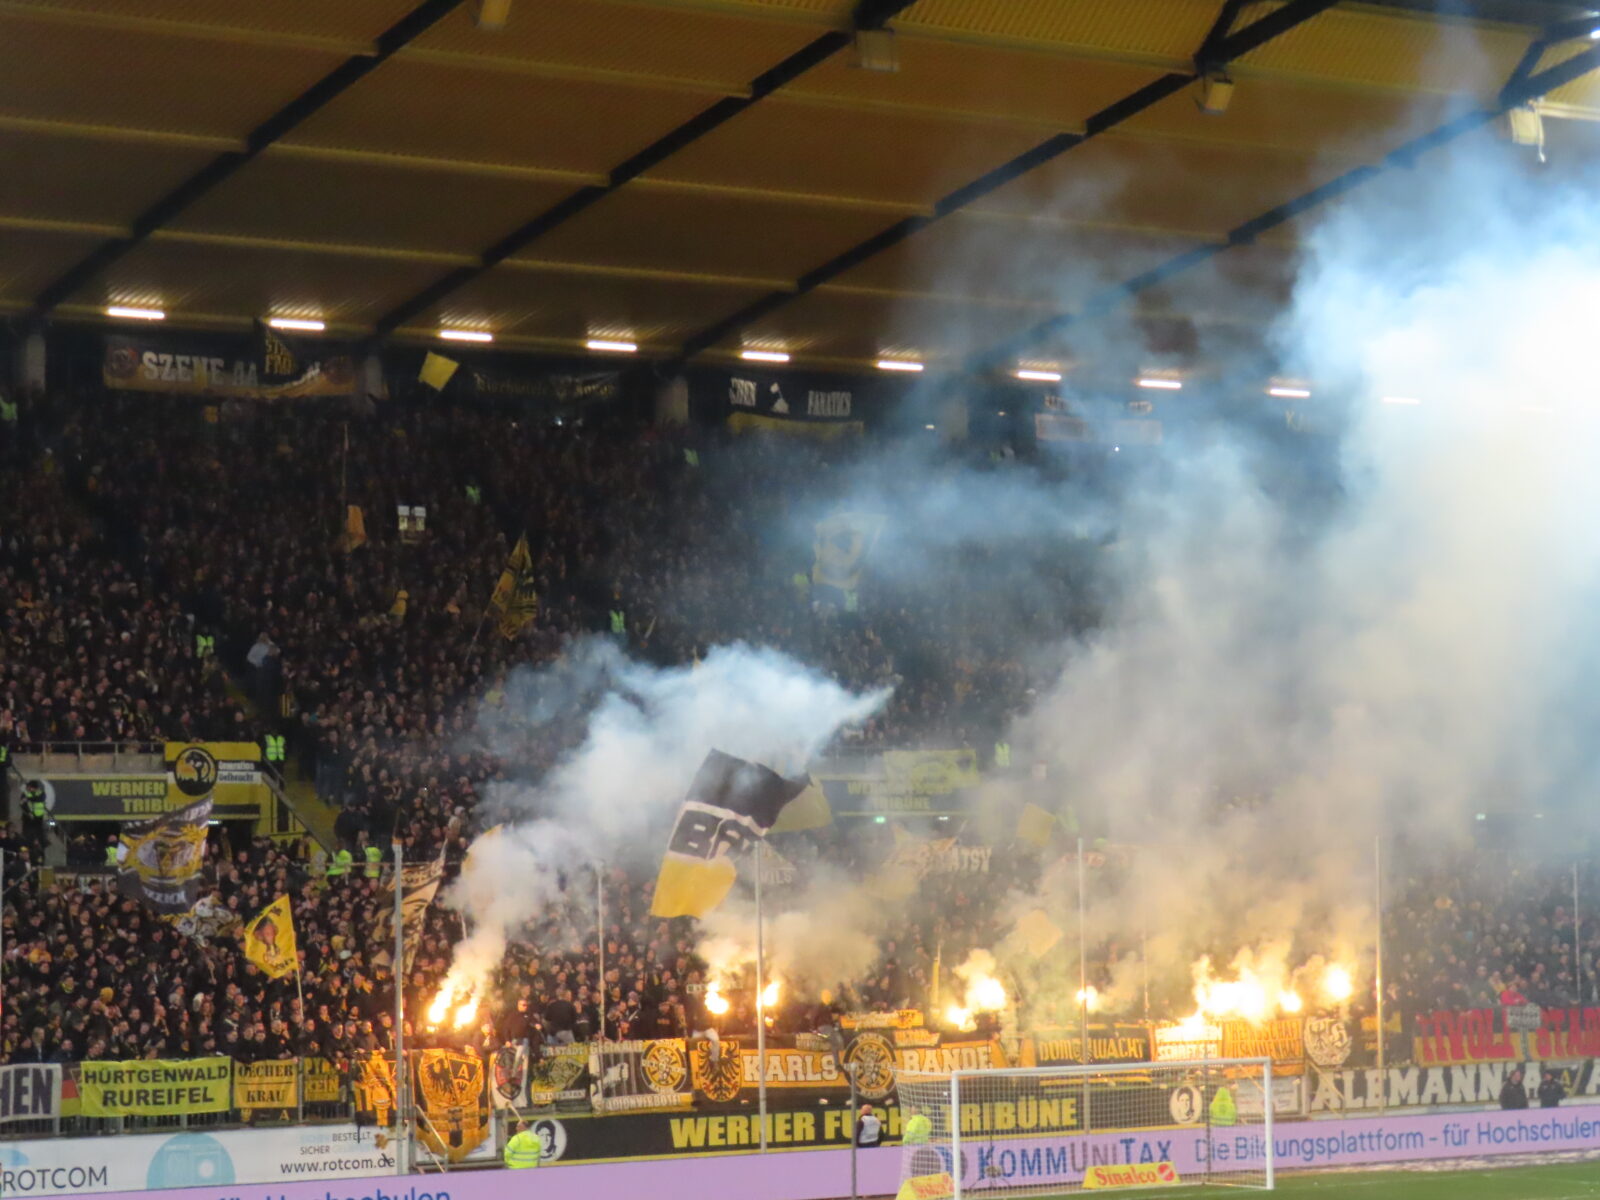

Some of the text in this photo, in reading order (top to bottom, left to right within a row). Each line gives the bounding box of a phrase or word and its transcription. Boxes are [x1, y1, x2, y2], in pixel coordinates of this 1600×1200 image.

[142, 351, 225, 385] SZENE
[92, 781, 165, 796] WERNER
[1414, 1008, 1516, 1061] TIVOLI
[1039, 1039, 1075, 1062] DOM
[1092, 1037, 1145, 1060] WACHT
[84, 1064, 228, 1085] HÜRTGENWALD
[239, 1064, 293, 1079] OECHER
[743, 1045, 991, 1082] KARLS BANDE
[102, 1086, 214, 1107] RUREIFEL
[1309, 1062, 1542, 1110] ALEMANNA
[671, 1112, 814, 1148] WERNER
[943, 1096, 1077, 1134] TRIBÜNE
[300, 1145, 330, 1155] SICHER
[1195, 1138, 1230, 1162] Die
[1443, 1124, 1469, 1146] für
[281, 1157, 395, 1174] www.rotcom.de
[1094, 1165, 1157, 1187] Sinalco
[2, 1166, 108, 1192] ROTCOM
